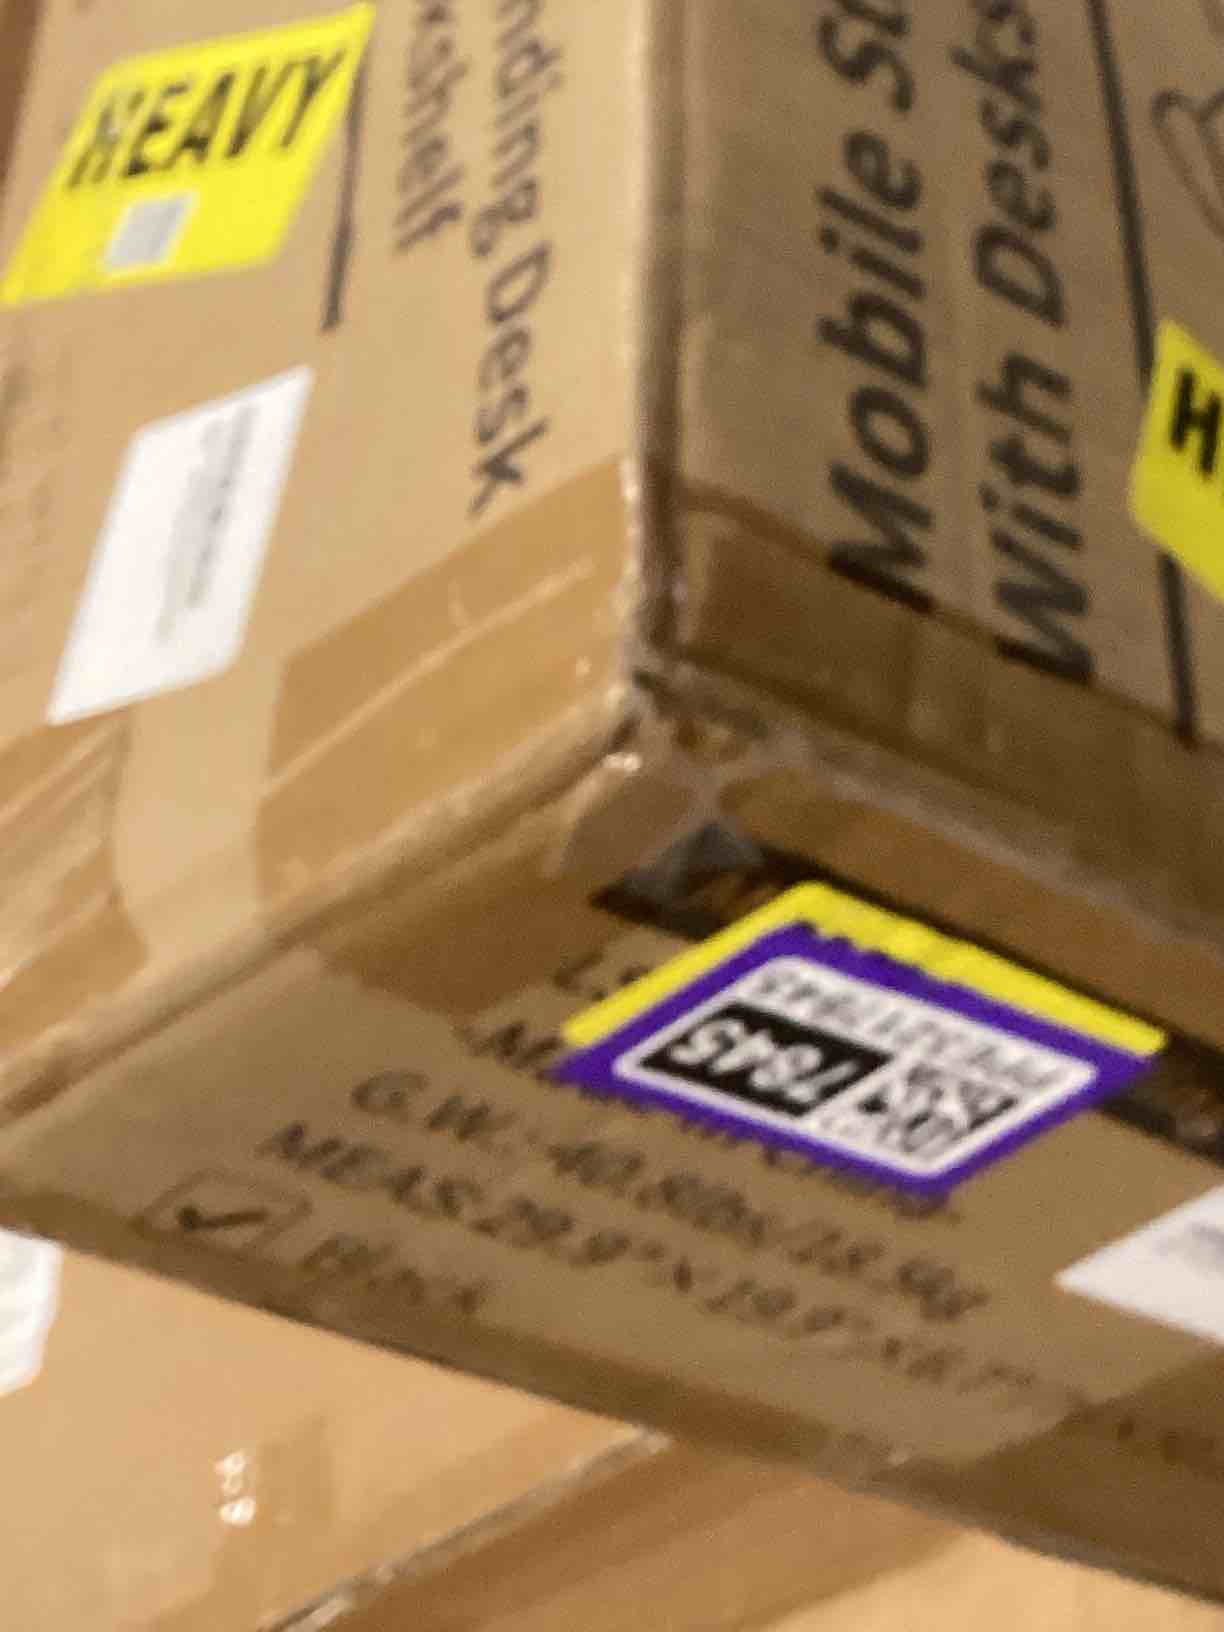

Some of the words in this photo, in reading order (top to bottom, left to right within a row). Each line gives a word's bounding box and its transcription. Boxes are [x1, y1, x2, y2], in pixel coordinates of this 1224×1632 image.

[68, 50, 347, 190] HEAVY
[469, 240, 552, 520] Desk
[815, 130, 936, 614] Mobile
[974, 350, 1096, 681] With
[666, 1016, 856, 1106] 7845
